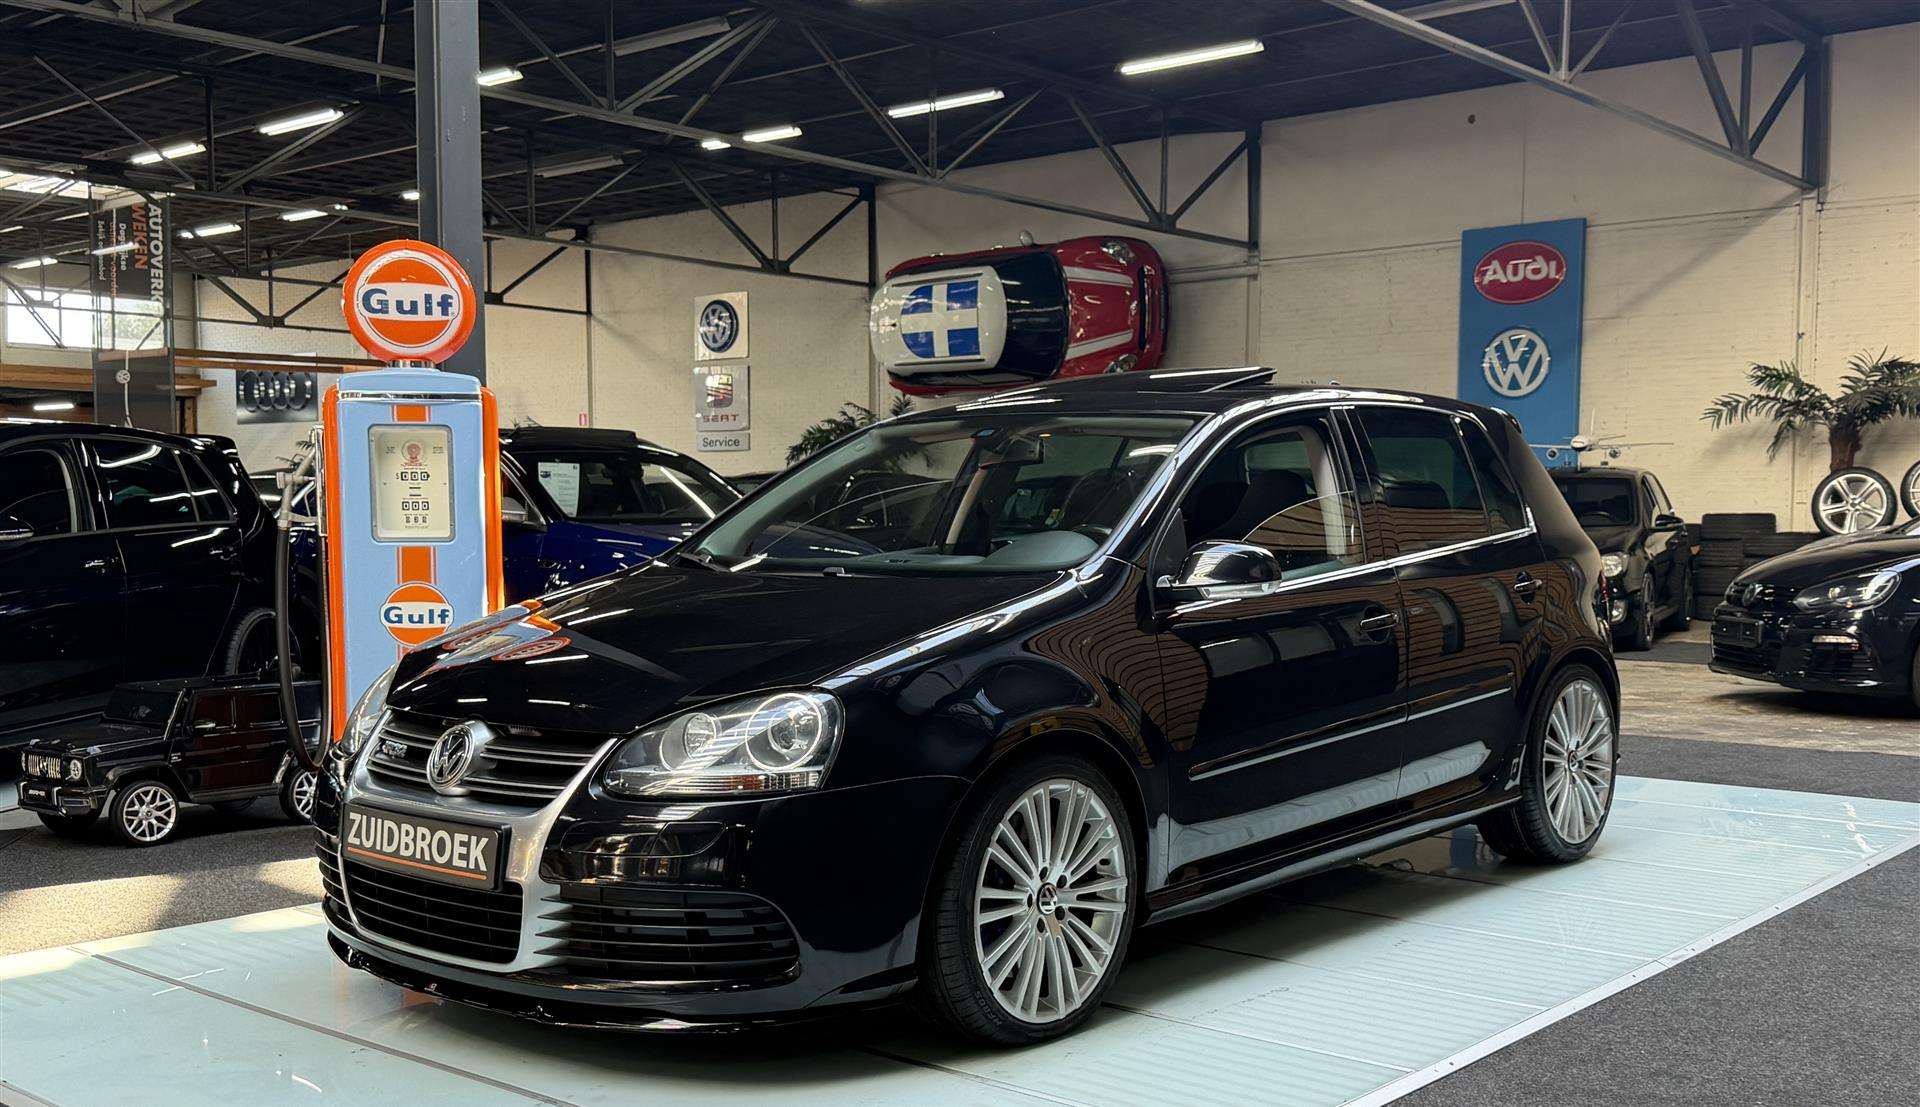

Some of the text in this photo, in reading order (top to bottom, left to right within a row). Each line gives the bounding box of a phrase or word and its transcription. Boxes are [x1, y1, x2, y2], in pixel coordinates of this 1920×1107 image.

[131, 202, 148, 270] WEKEN
[1480, 256, 1560, 285] Audi
[362, 288, 454, 317] Gulf
[703, 414, 739, 423] SEAT
[702, 437, 741, 448] Service
[383, 606, 450, 625] Gulf
[348, 812, 490, 872] ZUIDBROEK
